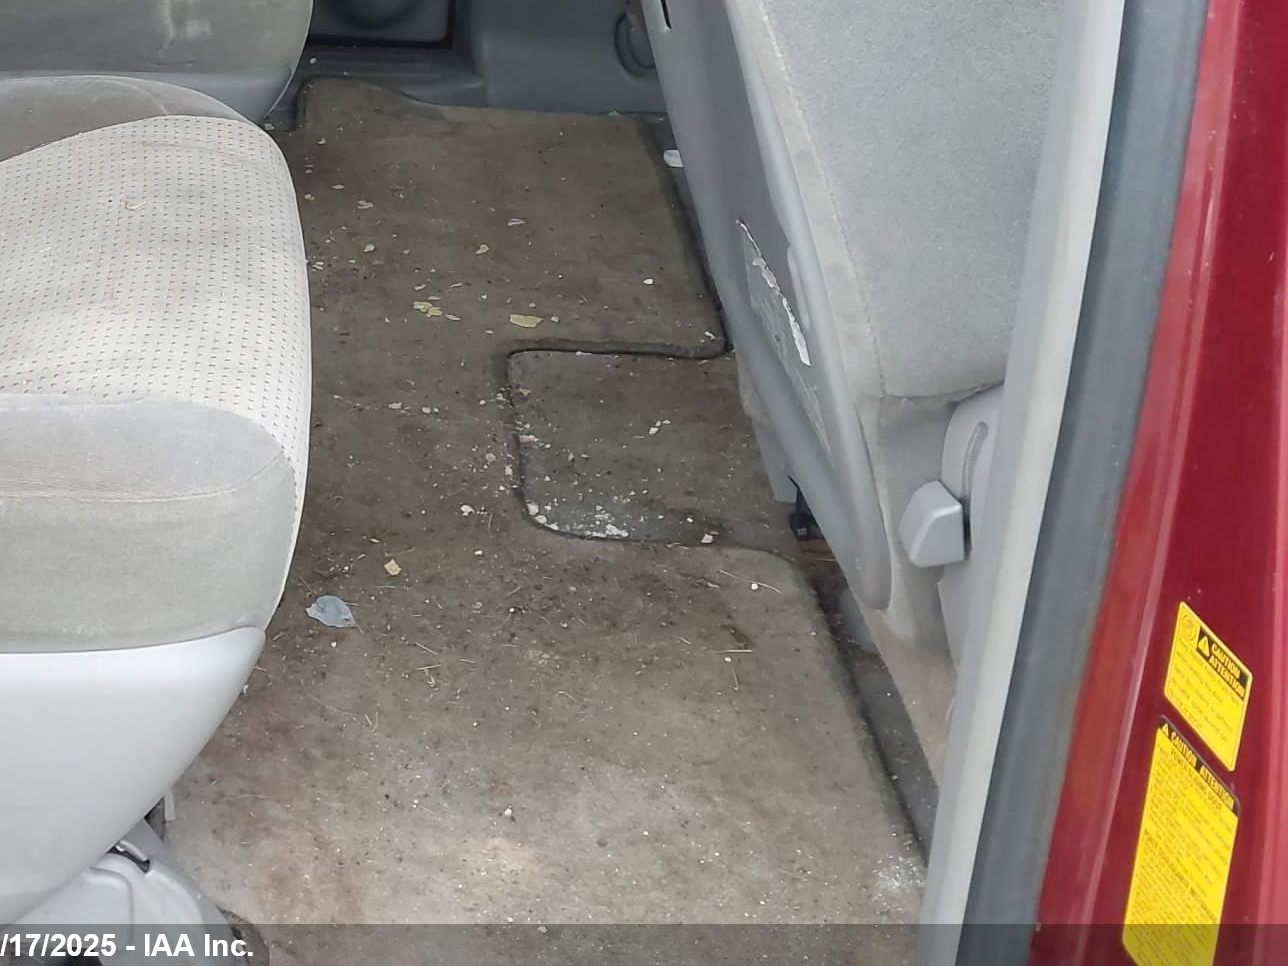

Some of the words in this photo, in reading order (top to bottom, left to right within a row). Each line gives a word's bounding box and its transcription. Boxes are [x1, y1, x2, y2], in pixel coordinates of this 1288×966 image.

[1208, 654, 1245, 697] ATTENTION
[1212, 642, 1241, 680] CAUTION
[1171, 731, 1197, 768] CAUTION
